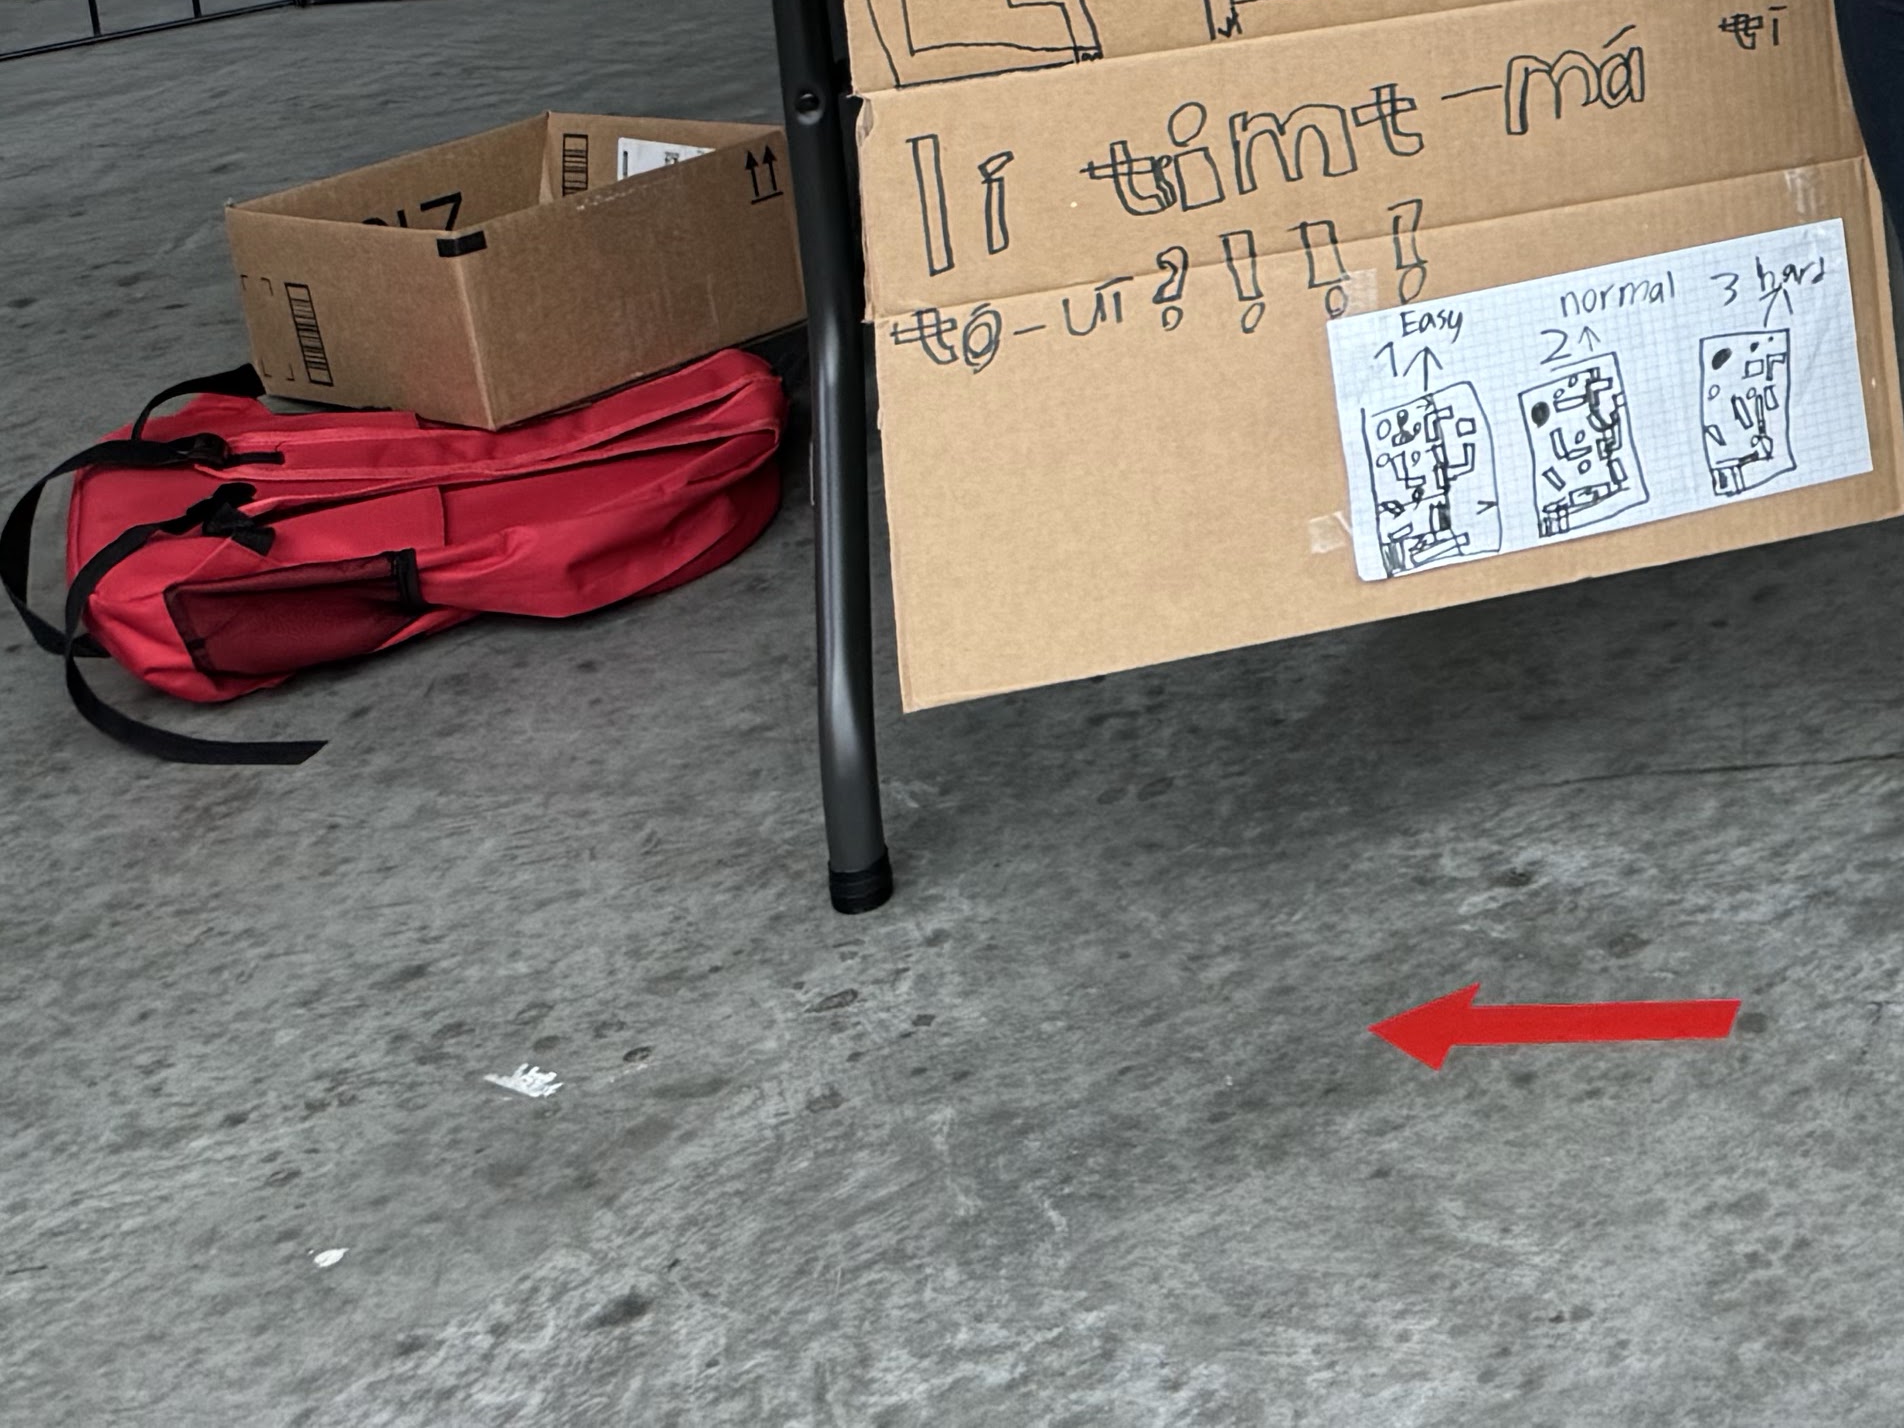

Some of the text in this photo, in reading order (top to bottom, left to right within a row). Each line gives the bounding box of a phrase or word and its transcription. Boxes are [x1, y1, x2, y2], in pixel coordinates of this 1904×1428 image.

[1559, 270, 1676, 318] normal
[1710, 256, 1825, 306] 3 hard
[1400, 309, 1464, 344] Easy
[1539, 328, 1574, 366] 2
